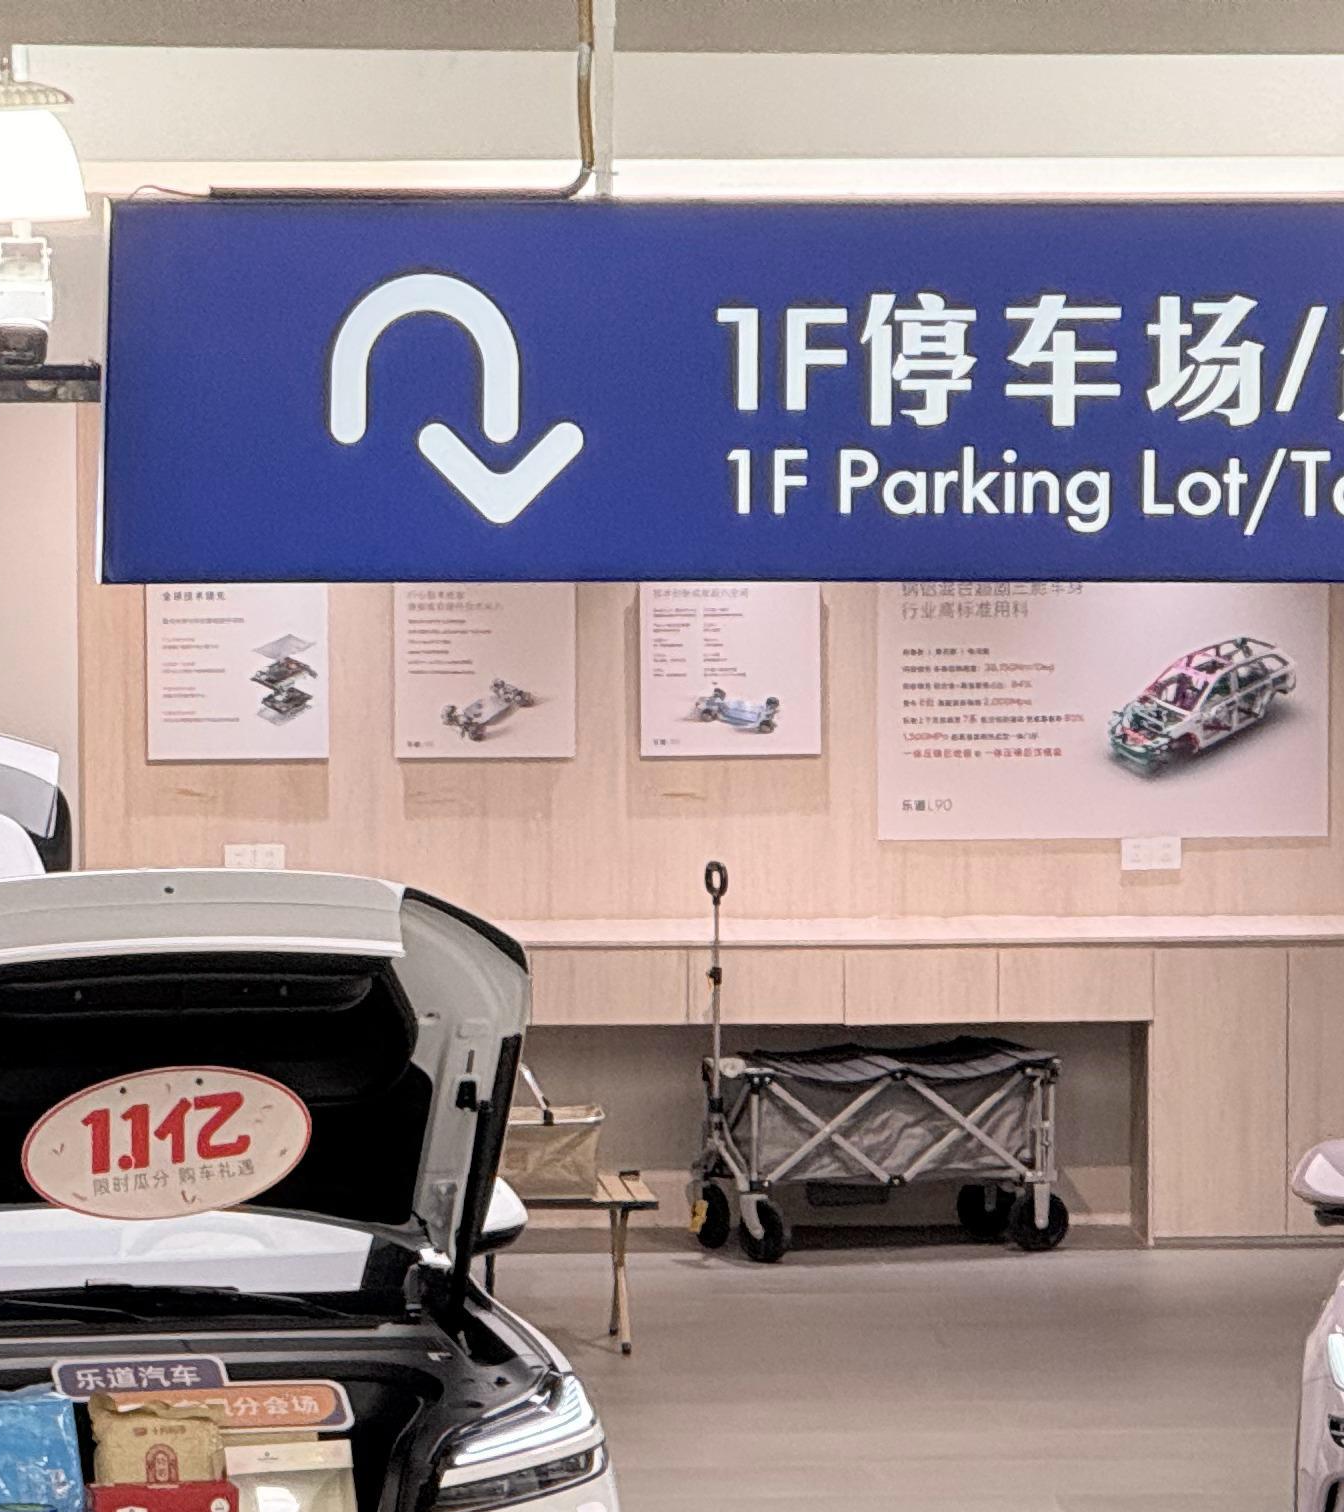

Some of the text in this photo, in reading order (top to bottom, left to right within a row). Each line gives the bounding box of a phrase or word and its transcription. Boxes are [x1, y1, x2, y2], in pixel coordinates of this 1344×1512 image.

[726, 449, 807, 517] 1F
[839, 448, 1108, 534] Parking
[76, 1364, 202, 1391] 乐道汽车
